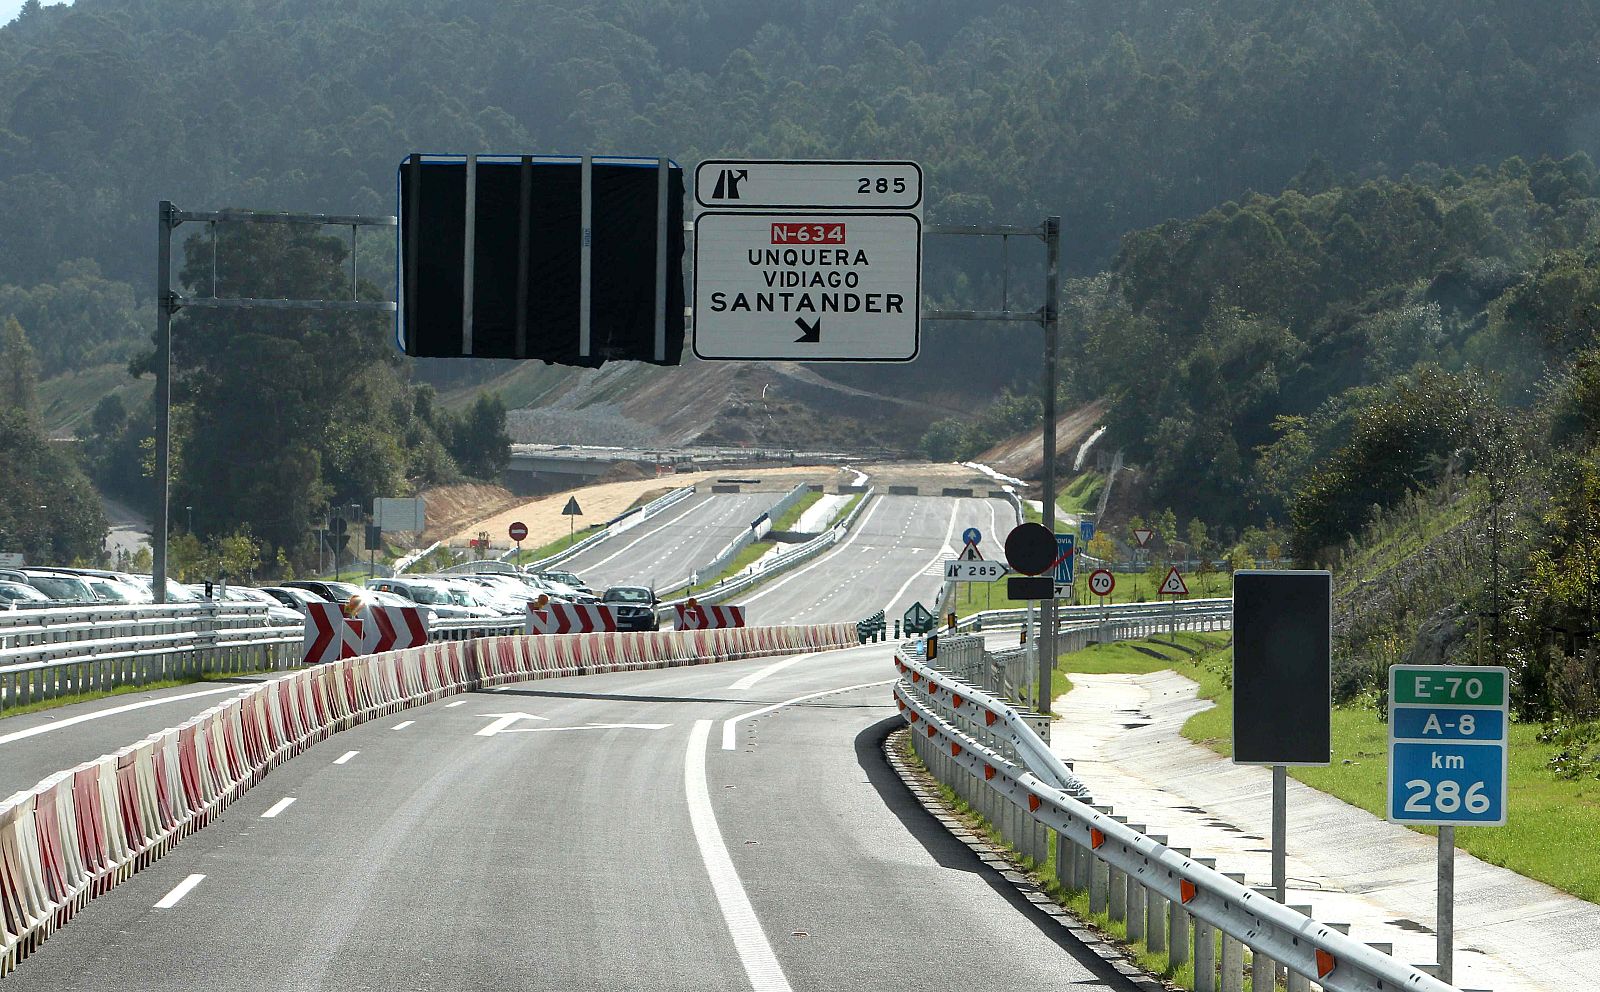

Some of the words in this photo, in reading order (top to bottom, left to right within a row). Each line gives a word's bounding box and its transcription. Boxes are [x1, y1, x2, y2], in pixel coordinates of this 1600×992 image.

[857, 178, 906, 194] 285
[773, 226, 843, 242] N-634
[748, 249, 869, 266] UNQUERA
[763, 271, 860, 288] VIDIAGO
[710, 293, 904, 313] SANTANDER
[968, 566, 997, 576] 285
[1094, 578, 1110, 588] 70
[1414, 677, 1484, 699] E-70
[1422, 714, 1476, 735] A-8
[1431, 752, 1465, 769] km
[1404, 780, 1491, 814] 286
